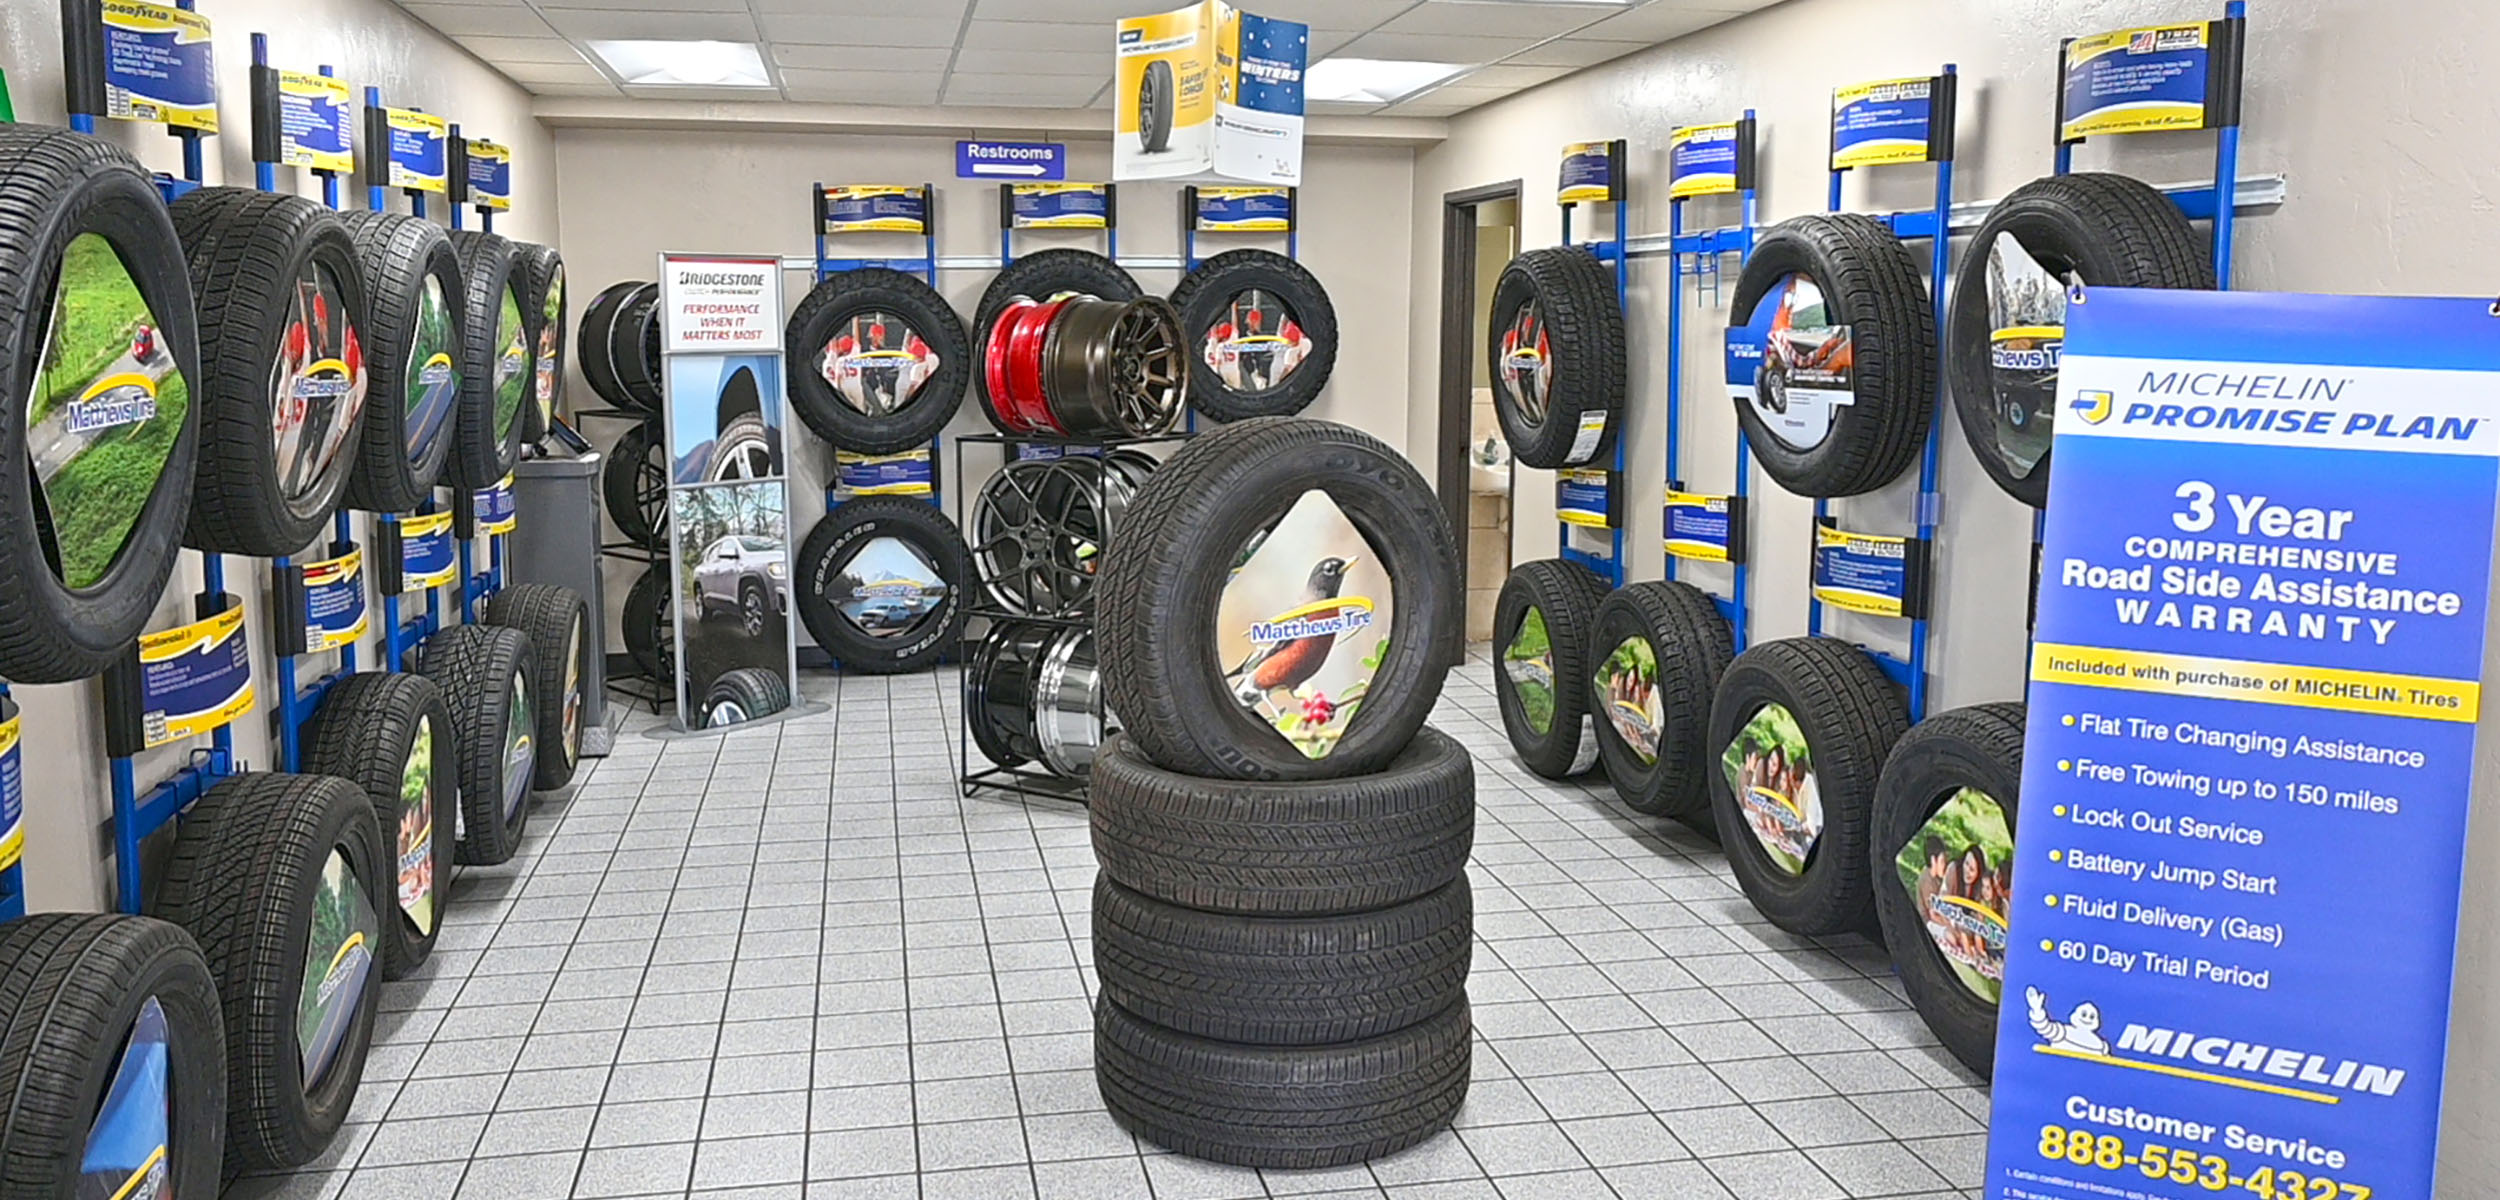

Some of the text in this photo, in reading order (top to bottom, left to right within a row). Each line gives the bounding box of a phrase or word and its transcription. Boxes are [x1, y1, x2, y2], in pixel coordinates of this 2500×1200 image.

[1240, 61, 1301, 83] WINTERS
[968, 143, 1053, 160] Restrooms
[679, 271, 765, 286] BRIDGESTONE
[683, 303, 760, 314] PERFORMANCE
[700, 317, 745, 328] WHEN IT
[682, 330, 763, 341] MATTERS MOST
[2137, 371, 2349, 401] MICHELIN
[68, 400, 131, 431] Matthews
[2122, 402, 2480, 441] PROMISE PLAN
[2172, 481, 2353, 541] 3 Year
[814, 521, 876, 596] WRANGLER
[2125, 536, 2398, 575] COMPREHENSIVE
[2062, 558, 2461, 616] Road Side Assistance
[896, 584, 960, 659] GOODYEAR
[1251, 609, 1372, 643] Matthews Tire
[2116, 598, 2397, 645] WARRANTY
[2048, 656, 2460, 709] Included with purchase of MICHELIN Tires
[2080, 713, 2426, 768] Flat Tire Changing Assistance
[2076, 758, 2400, 815] Free Towing up to 150 miles
[2072, 803, 2264, 847] Lock Out Service
[2067, 848, 2278, 896] Battery Jump Start
[2062, 893, 2285, 949] Fluid Delivery (Gas)
[2058, 940, 2271, 991] 60 Day Trial Period
[2116, 1022, 2407, 1098] MICHELIN
[2065, 1094, 2347, 1171] Customer Service
